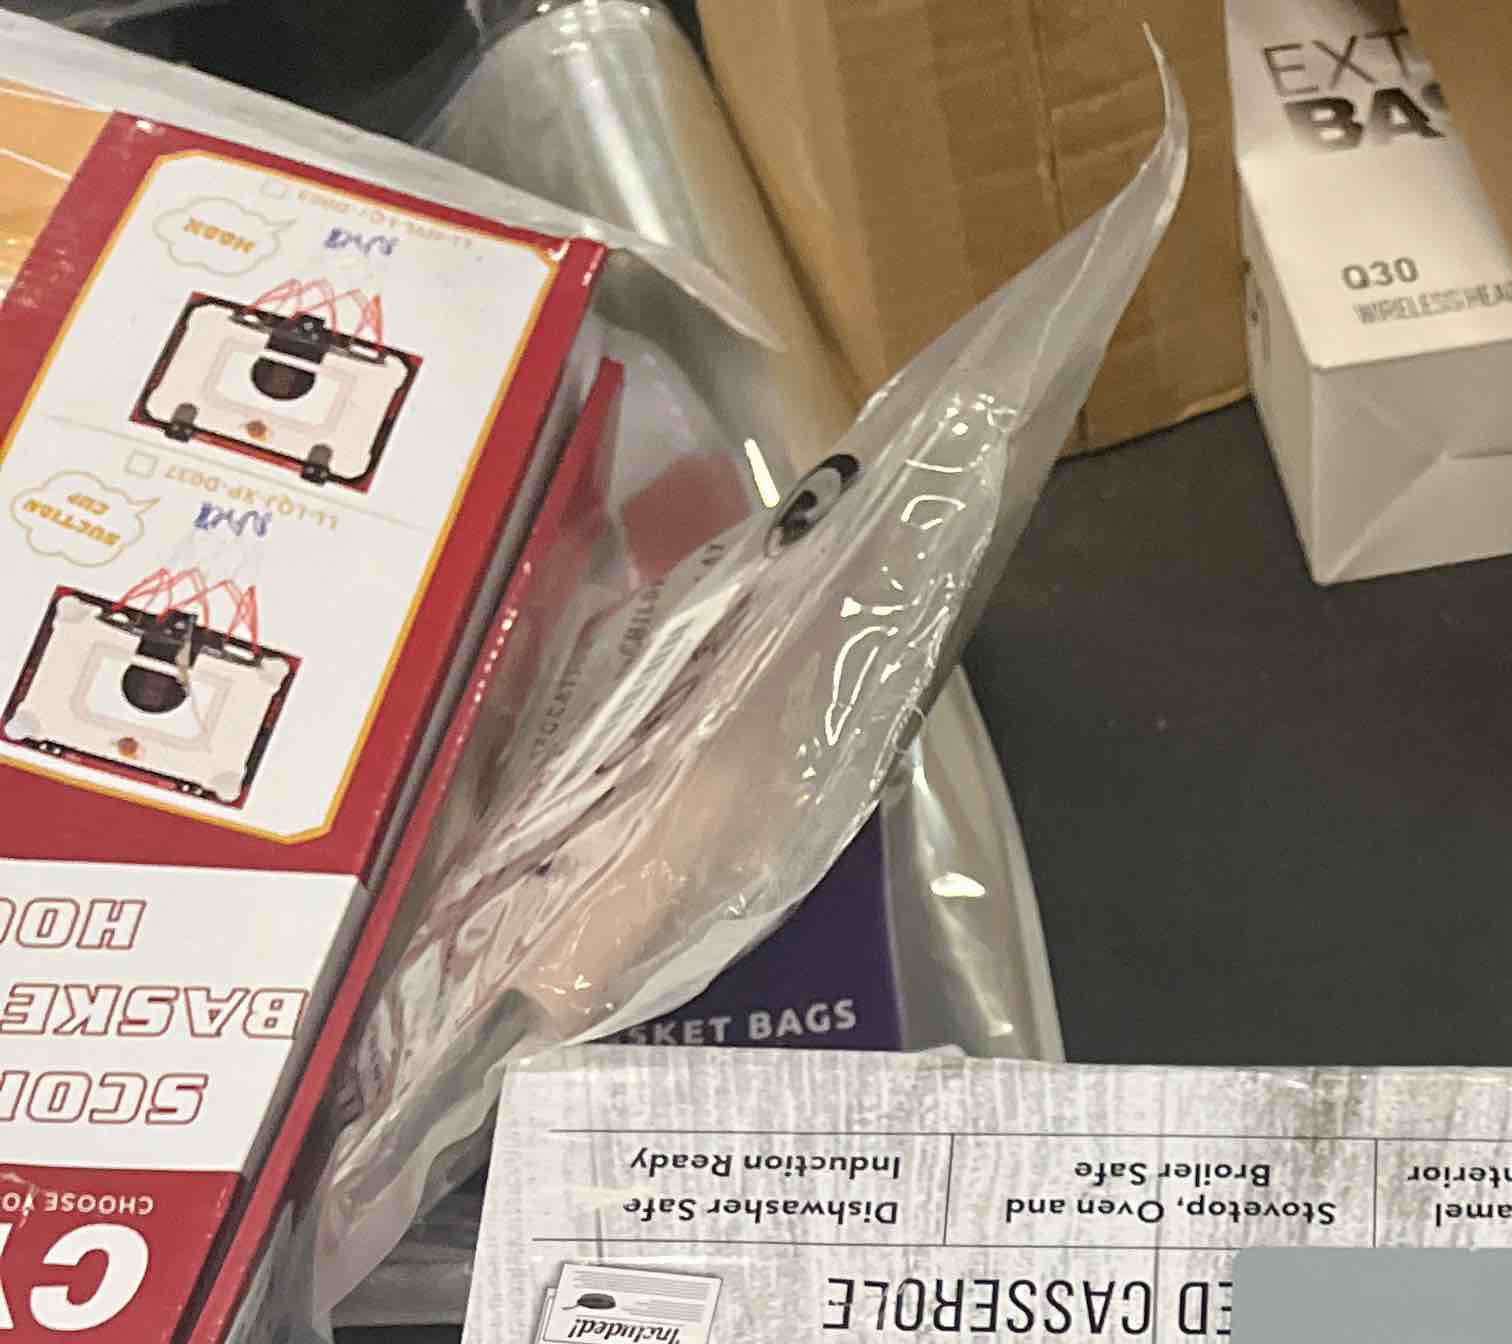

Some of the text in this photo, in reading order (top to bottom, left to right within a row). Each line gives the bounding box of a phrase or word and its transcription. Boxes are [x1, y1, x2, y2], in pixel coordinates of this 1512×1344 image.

[1342, 257, 1419, 290] Q30
[749, 999, 857, 1041] BAGS
[630, 1147, 901, 1179] Induction Ready
[1075, 1160, 1272, 1187] Broiler Safe
[43, 1191, 153, 1216] CHOOSE
[623, 1197, 899, 1225] Dishwasher Safe
[1006, 1194, 1338, 1226] Stovetop, Oven and
[822, 1277, 1153, 1336] CASSEROLE
